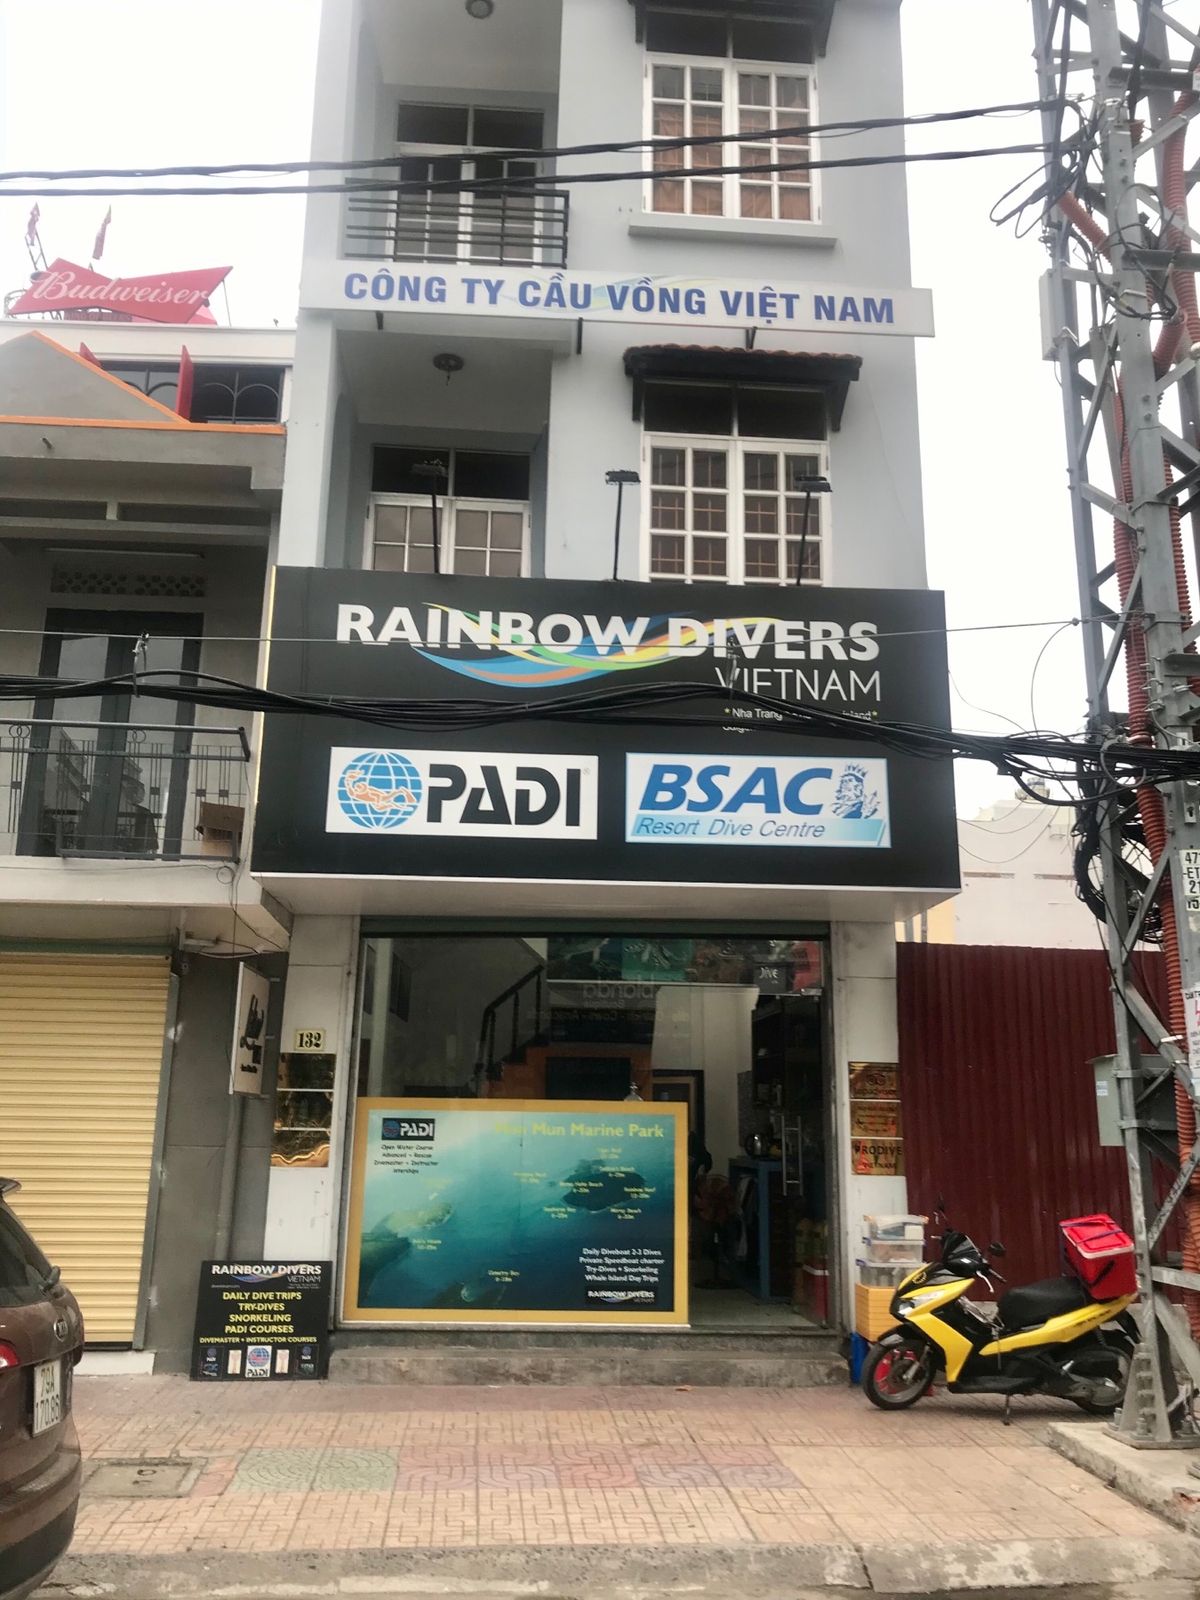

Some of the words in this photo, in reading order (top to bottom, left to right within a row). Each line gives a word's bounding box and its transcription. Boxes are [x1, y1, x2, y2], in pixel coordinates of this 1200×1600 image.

[31, 270, 210, 305] Budweiser
[344, 268, 447, 303] CÔNG
[461, 278, 505, 305] TY
[518, 272, 592, 310] CẦU
[607, 277, 706, 315] VỒNG
[720, 286, 800, 324] VIỆT
[813, 294, 895, 324] NAM
[336, 603, 651, 656] RAINBOW
[667, 617, 880, 662] DIVERS
[732, 708, 753, 719] Nha
[754, 708, 783, 722] Trang
[427, 763, 581, 827] PADI
[638, 763, 833, 816] BSAC
[636, 817, 700, 837] Resort
[708, 818, 753, 836] Dive
[759, 819, 826, 839] Centre
[297, 1032, 322, 1049] 132
[400, 1123, 433, 1136] PADI
[532, 1122, 566, 1137] Mun
[570, 1123, 624, 1137] Marine
[628, 1123, 664, 1138] Park
[582, 1248, 600, 1257] Daily
[643, 1248, 662, 1256] Dives
[211, 1265, 275, 1275] RAINBOW
[277, 1264, 322, 1275] DIVERS
[287, 1275, 321, 1283] VIETNAM
[222, 1291, 249, 1300] DAILY
[251, 1291, 275, 1300] DIVE
[275, 1291, 302, 1301] TRIPS
[237, 1302, 286, 1311] TRY-DIVES
[228, 1313, 292, 1323] SNORKELING
[224, 1325, 248, 1334] PADI
[249, 1325, 295, 1334] COURSES
[199, 1336, 241, 1344] DIVEMASTER
[245, 1336, 287, 1344] INSTRUCTOR
[247, 1368, 269, 1377] PADI
